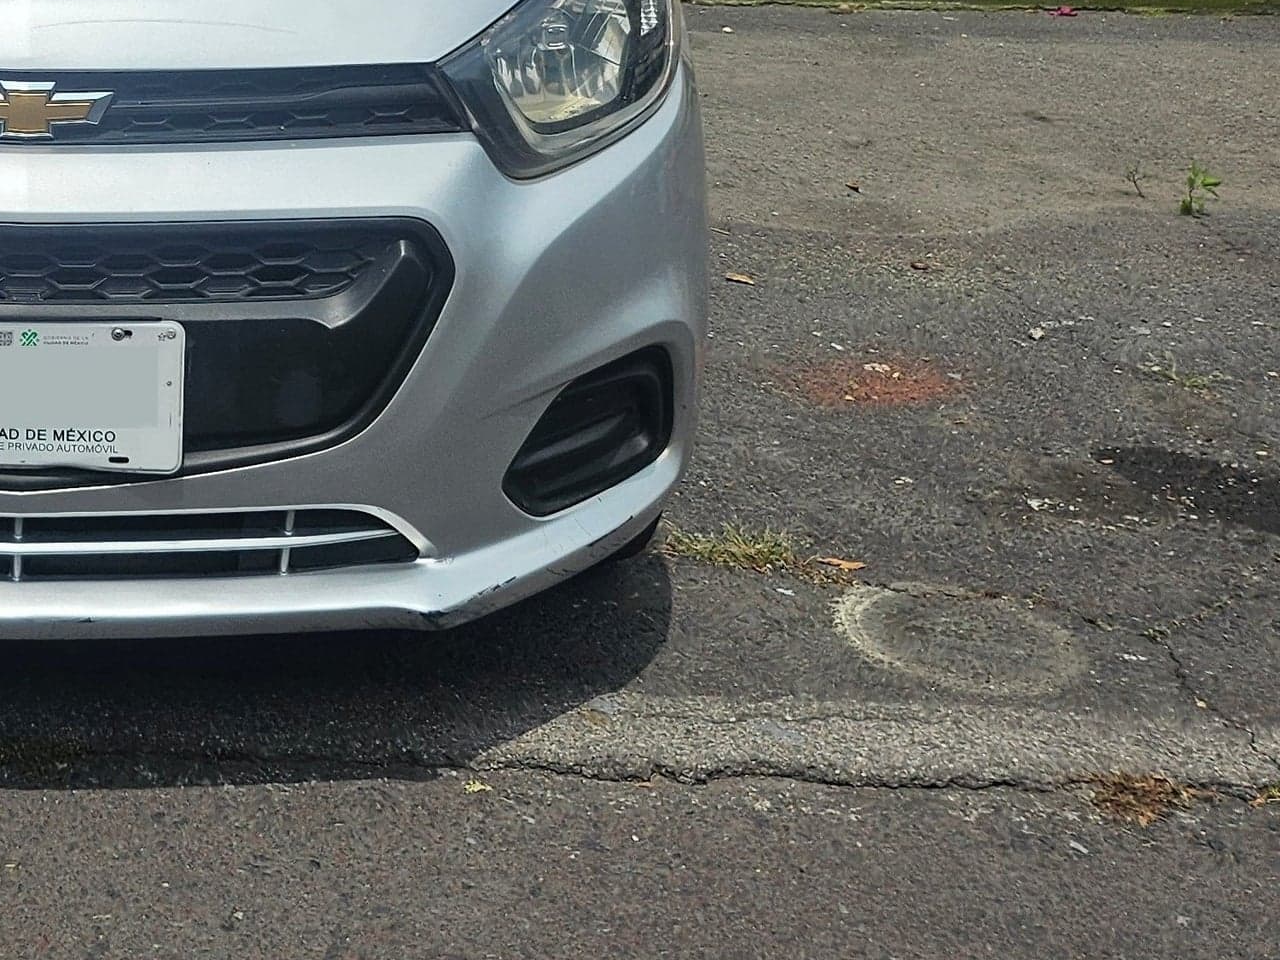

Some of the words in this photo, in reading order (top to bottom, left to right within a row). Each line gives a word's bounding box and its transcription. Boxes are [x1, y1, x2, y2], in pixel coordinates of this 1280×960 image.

[25, 429, 46, 441] DE
[53, 427, 116, 442] MÉXICO
[8, 442, 54, 452] PRIVADO
[56, 443, 118, 454] AUTOMÓVIL
